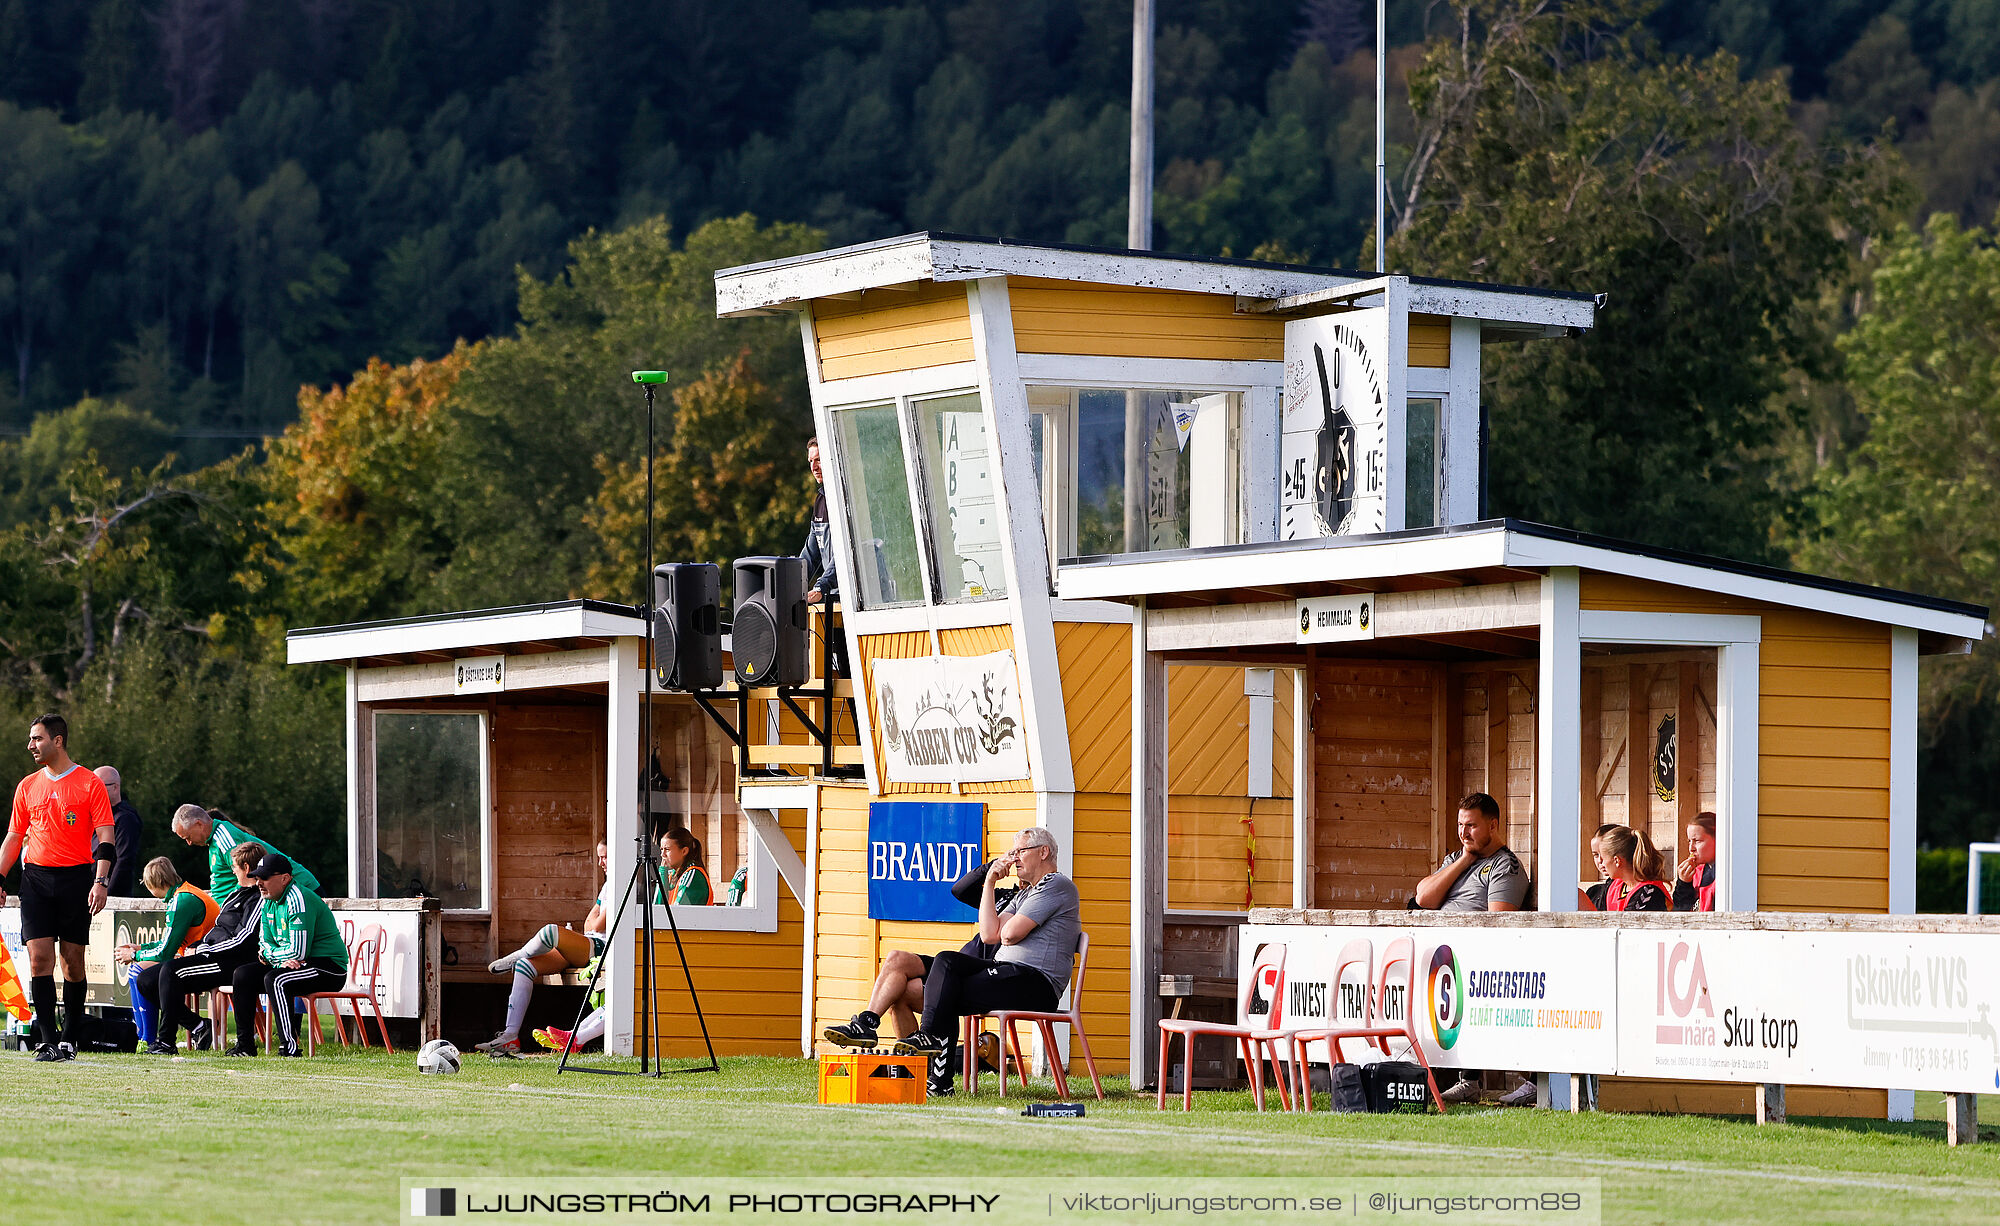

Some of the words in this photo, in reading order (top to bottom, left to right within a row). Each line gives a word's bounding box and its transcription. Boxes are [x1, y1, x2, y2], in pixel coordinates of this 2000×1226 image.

[948, 414, 958, 450] A
[949, 461, 957, 496] B
[1293, 458, 1306, 499] 45
[1366, 449, 1379, 492] 15
[1317, 609, 1352, 627] HEMMALAG
[902, 727, 953, 766] NABBEN
[954, 726, 980, 765] CUP
[871, 841, 978, 882] BRANDT
[1290, 981, 1327, 1018] INVEST
[1440, 973, 1451, 1021] S
[1469, 970, 1546, 999] SJOGERSTADS
[1657, 941, 1715, 1018] ICA
[1855, 954, 1921, 1007] Skövde
[1927, 956, 1968, 1009] VVS
[1470, 1003, 1493, 1026] ELNÄT
[1495, 1008, 1534, 1028] ELHANDEL
[1537, 1009, 1603, 1030] ELINSTALLATION
[1684, 1019, 1715, 1047] nära
[1723, 1006, 1754, 1047] Sku
[1760, 1012, 1798, 1059] torp
[1864, 1045, 1891, 1070] Jimmy
[1902, 1046, 1926, 1069] 0735
[1928, 1047, 1940, 1069] 36
